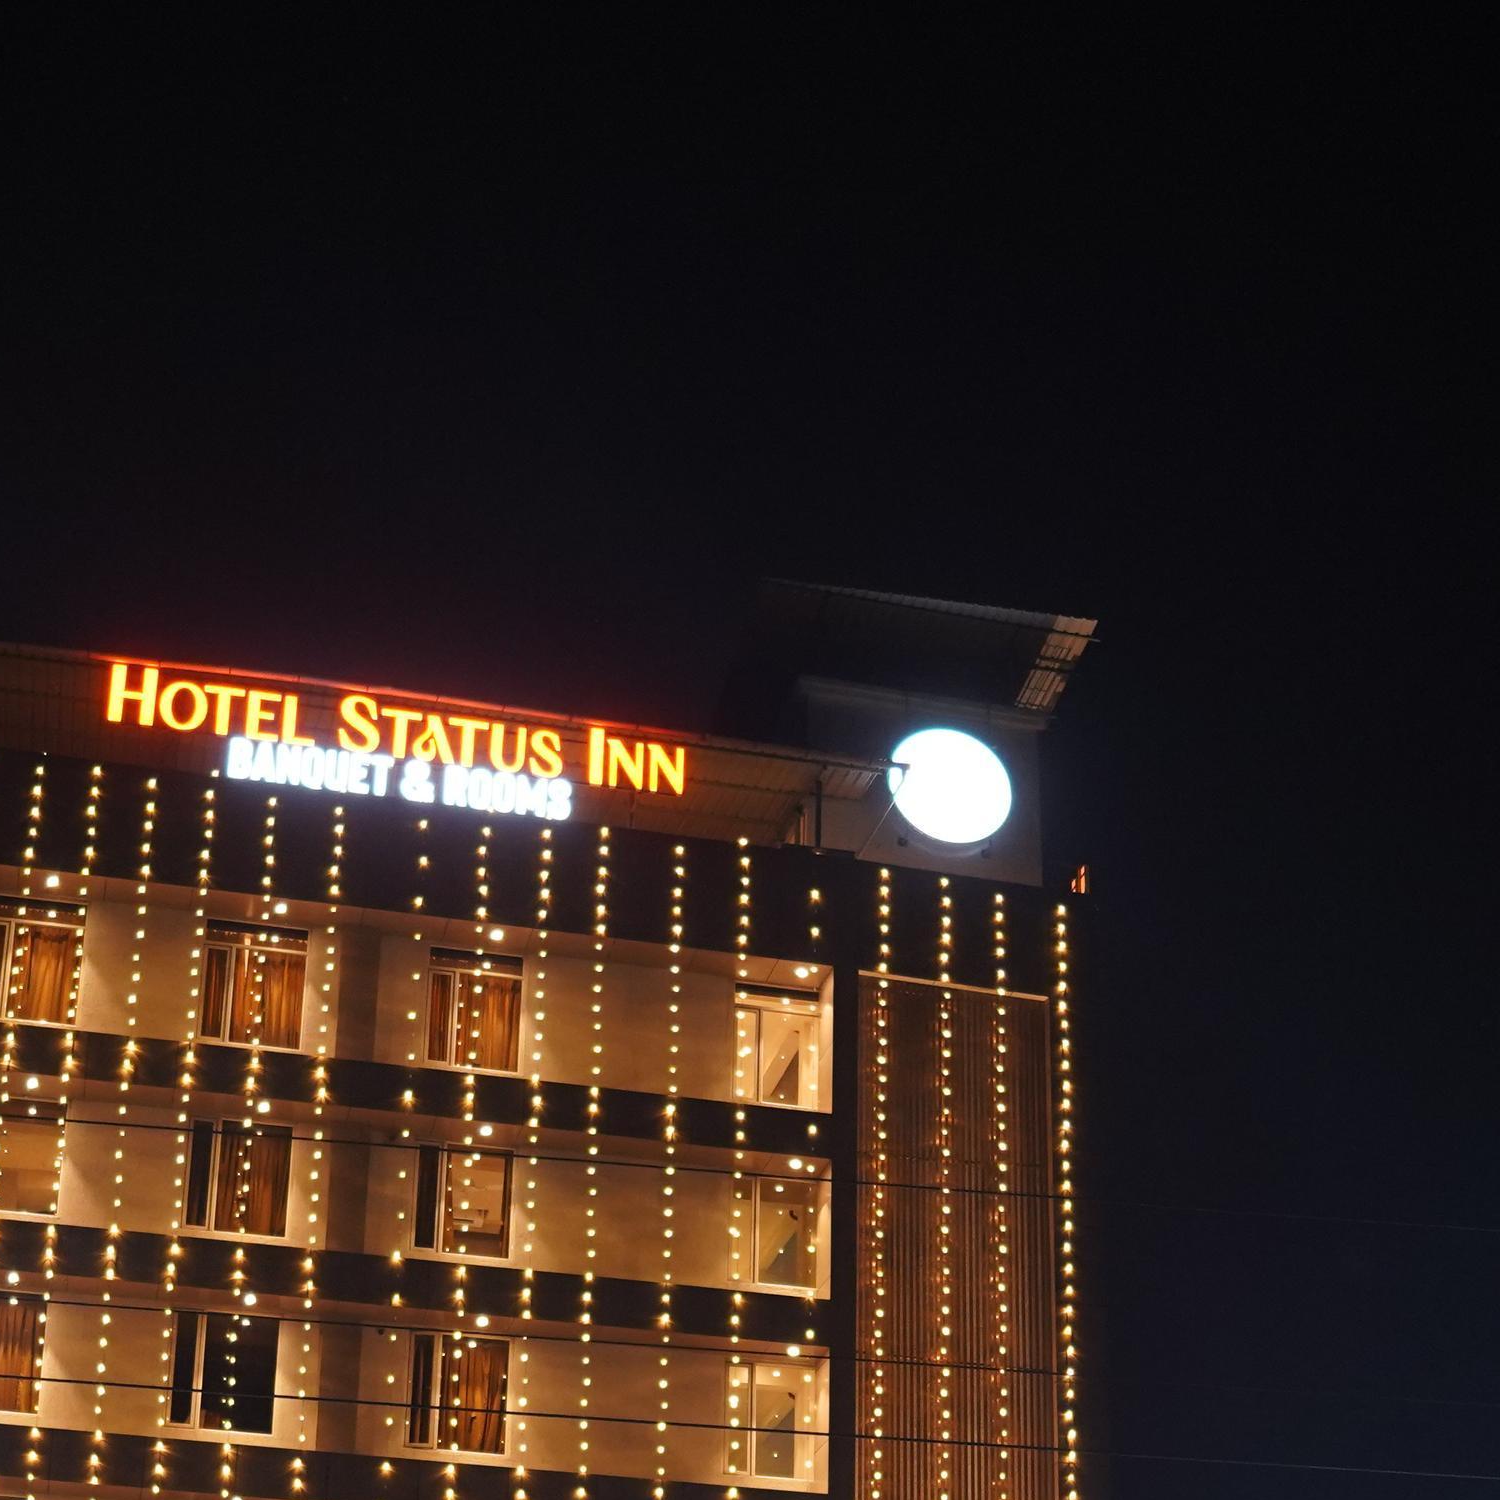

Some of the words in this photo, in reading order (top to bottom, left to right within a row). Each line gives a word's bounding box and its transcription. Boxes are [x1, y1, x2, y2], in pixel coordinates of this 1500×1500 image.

[105, 663, 315, 748] HOTEL
[336, 694, 564, 776] STATUS
[586, 726, 686, 796] INN
[225, 735, 396, 798] BANQUET
[399, 754, 436, 804] &
[441, 759, 573, 822] ROOMS
